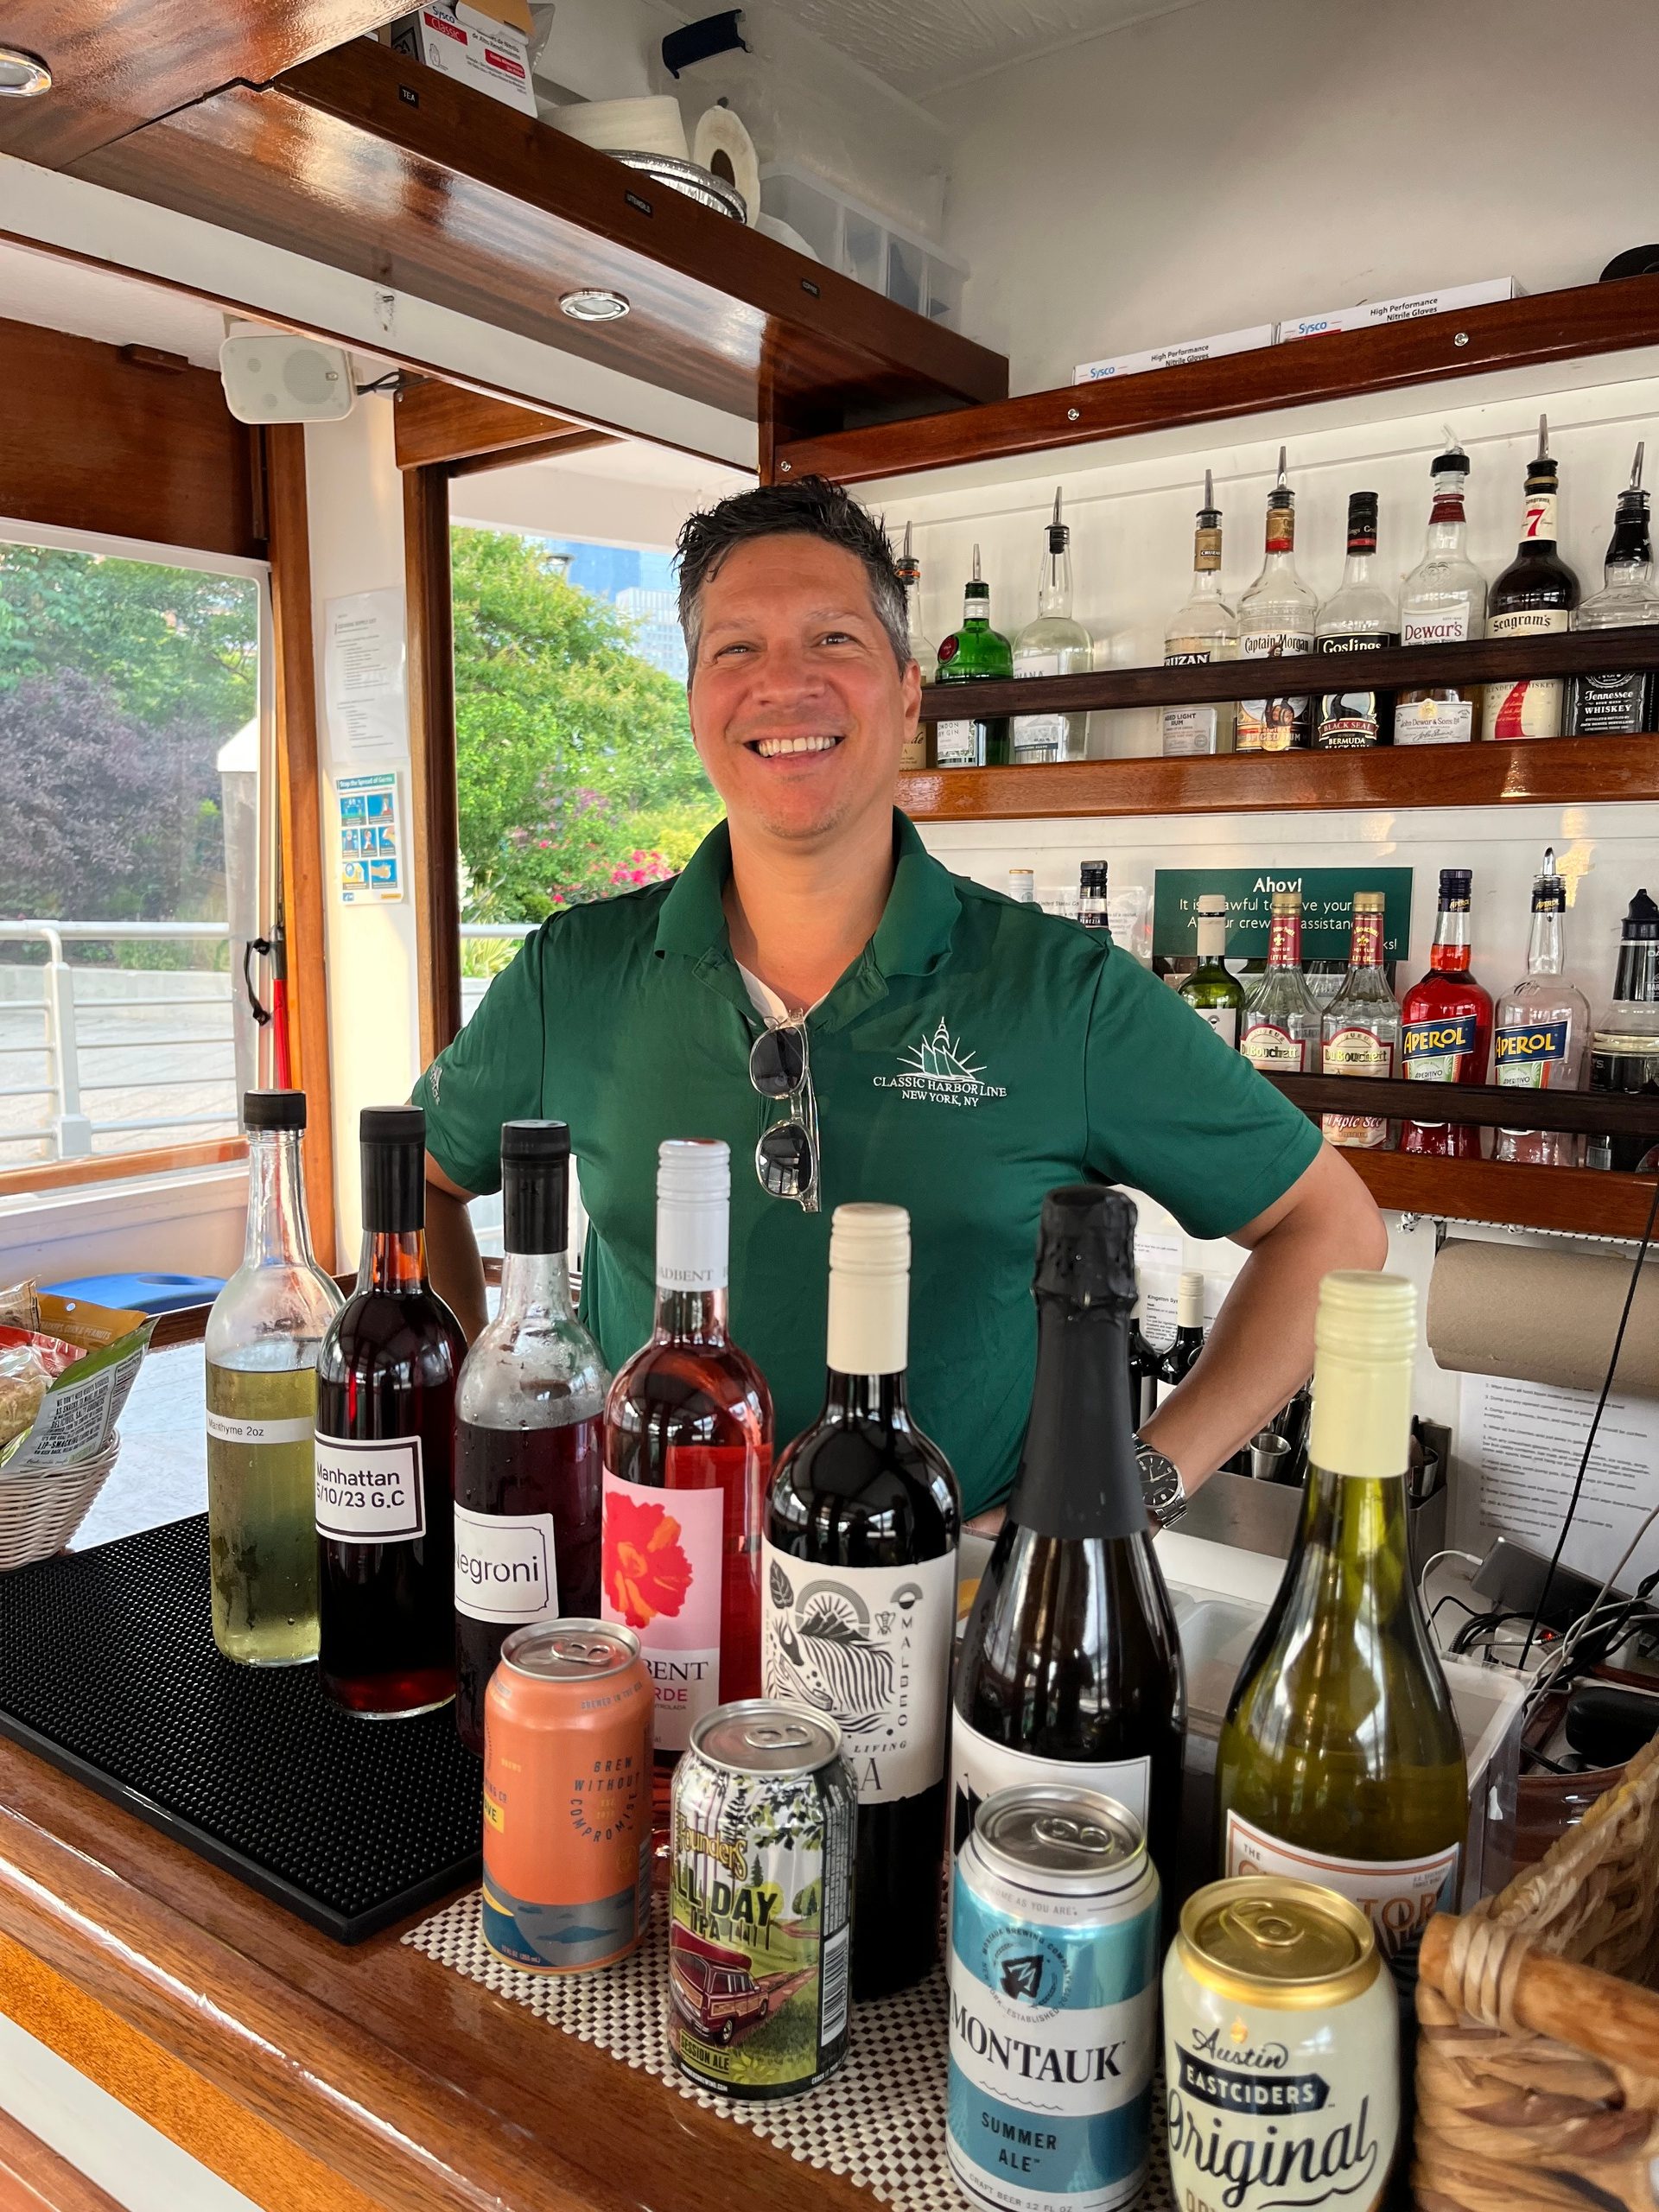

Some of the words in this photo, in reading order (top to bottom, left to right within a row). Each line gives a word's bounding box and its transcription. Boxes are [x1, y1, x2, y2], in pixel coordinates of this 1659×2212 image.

[432, 18, 461, 41] Classic
[403, 89, 416, 102] TEA
[1370, 307, 1388, 317] High
[1389, 297, 1438, 312] Performance
[1387, 311, 1410, 321] Nitrile
[1412, 307, 1438, 317] Gloves
[1298, 321, 1327, 334] Sysco
[1151, 353, 1166, 362] High
[1167, 345, 1209, 359] Performance
[1090, 366, 1115, 379] Sysco
[1527, 508, 1546, 537] 7
[1405, 621, 1463, 641] Dewar's
[1493, 614, 1551, 633] Seagram's
[1244, 636, 1276, 653] Captain
[1278, 634, 1309, 652] Morgan
[1164, 654, 1208, 666] RUZAN
[1585, 690, 1633, 702] Tennessee
[1176, 712, 1197, 721] LIGHT
[1584, 704, 1632, 715] WHISKEY
[1323, 721, 1349, 732] BLACK
[1351, 720, 1372, 730] SEAL
[1179, 899, 1188, 911] It
[1239, 918, 1270, 929] crew
[1403, 1027, 1465, 1053] APEROL
[1496, 1033, 1556, 1058] APEROL
[873, 1077, 925, 1089] CLASSIC
[928, 1081, 978, 1095] HARBOR
[980, 1085, 1007, 1097] LINE
[901, 1090, 928, 1101] NEW
[928, 1092, 962, 1107] YORK,
[963, 1096, 979, 1107] NY
[246, 1427, 264, 1438] 2oz
[37, 1436, 79, 1450] LIP-SMACKING
[316, 1461, 400, 1487] Manhattan
[371, 1490, 405, 1510] G.C
[854, 1740, 907, 1753] LIVING
[594, 1756, 632, 1773] BREW
[575, 1771, 641, 1792] WITHOUT
[484, 1797, 498, 1823] AVE
[677, 1812, 748, 1882] Founders
[1243, 1842, 1262, 1861] THE
[710, 1880, 779, 1928] DAY
[1016, 1897, 1027, 1909] AS
[1032, 1901, 1049, 1913] YOU
[693, 1910, 721, 1942] IPA
[1005, 1927, 1046, 1944] BREWING
[1006, 2006, 1060, 2023] ESTABLISHED
[951, 1990, 1122, 2084] MONTAUK
[681, 2037, 710, 2063] SESSION
[713, 2056, 730, 2071] ALE
[1192, 2027, 1289, 2070] Austin
[1186, 2064, 1316, 2106] EASTCIDERS
[981, 2112, 1058, 2151] SUMMER
[1166, 2088, 1378, 2211] Original
[969, 2173, 994, 2194] CRAFT
[996, 2191, 1022, 2207] BEER
[1027, 2202, 1037, 2211] 12
[1044, 2203, 1055, 2212] FL
